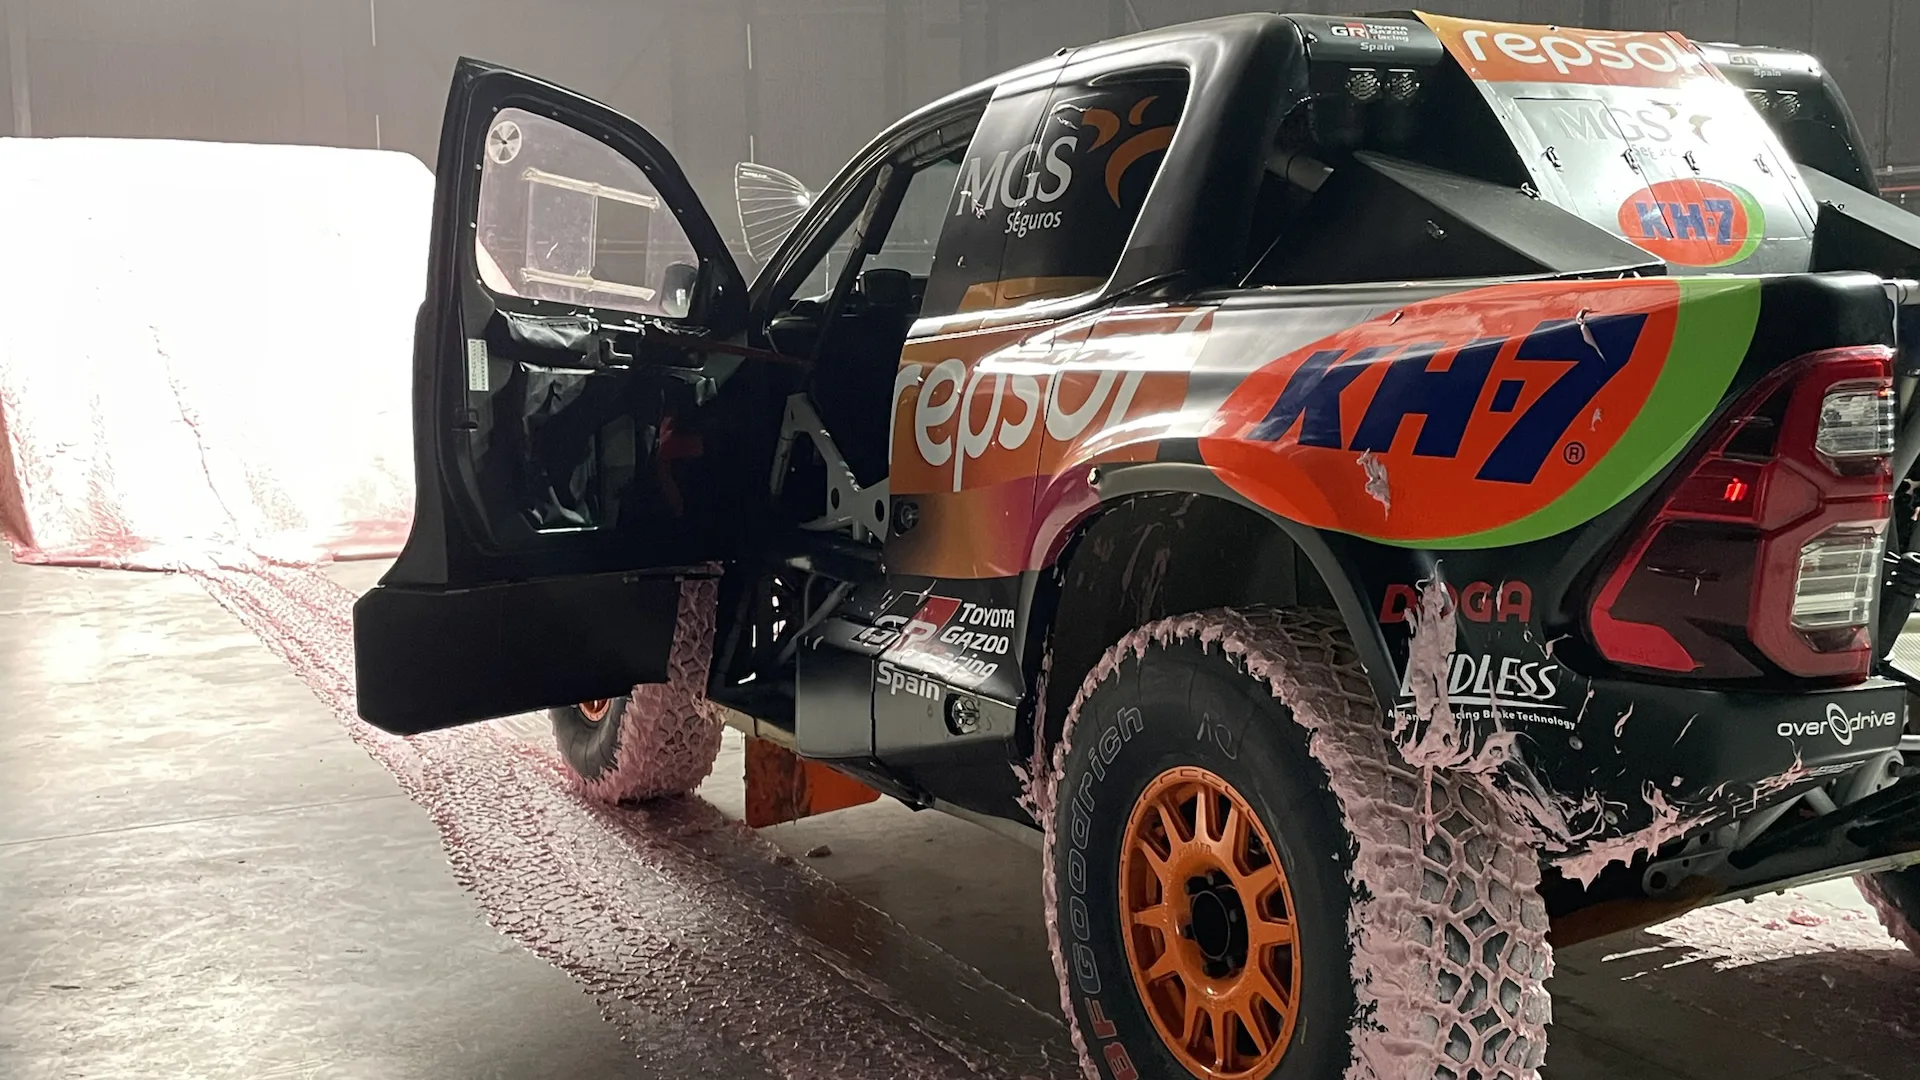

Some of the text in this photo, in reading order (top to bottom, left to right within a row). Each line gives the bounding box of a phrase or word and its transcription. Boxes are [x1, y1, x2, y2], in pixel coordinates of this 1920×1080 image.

[1331, 26, 1365, 37] GR
[1360, 42, 1395, 52] Spain
[1462, 29, 1694, 75] repsol
[1753, 68, 1781, 78] Spain
[1551, 106, 1673, 142] MGS
[955, 136, 1079, 217] MGS
[1004, 211, 1062, 238] Seguros
[959, 603, 1015, 629] TOYOTA
[940, 625, 1010, 655] GAZOO
[876, 661, 940, 701] Spain
[1516, 711, 1576, 732] Technology
